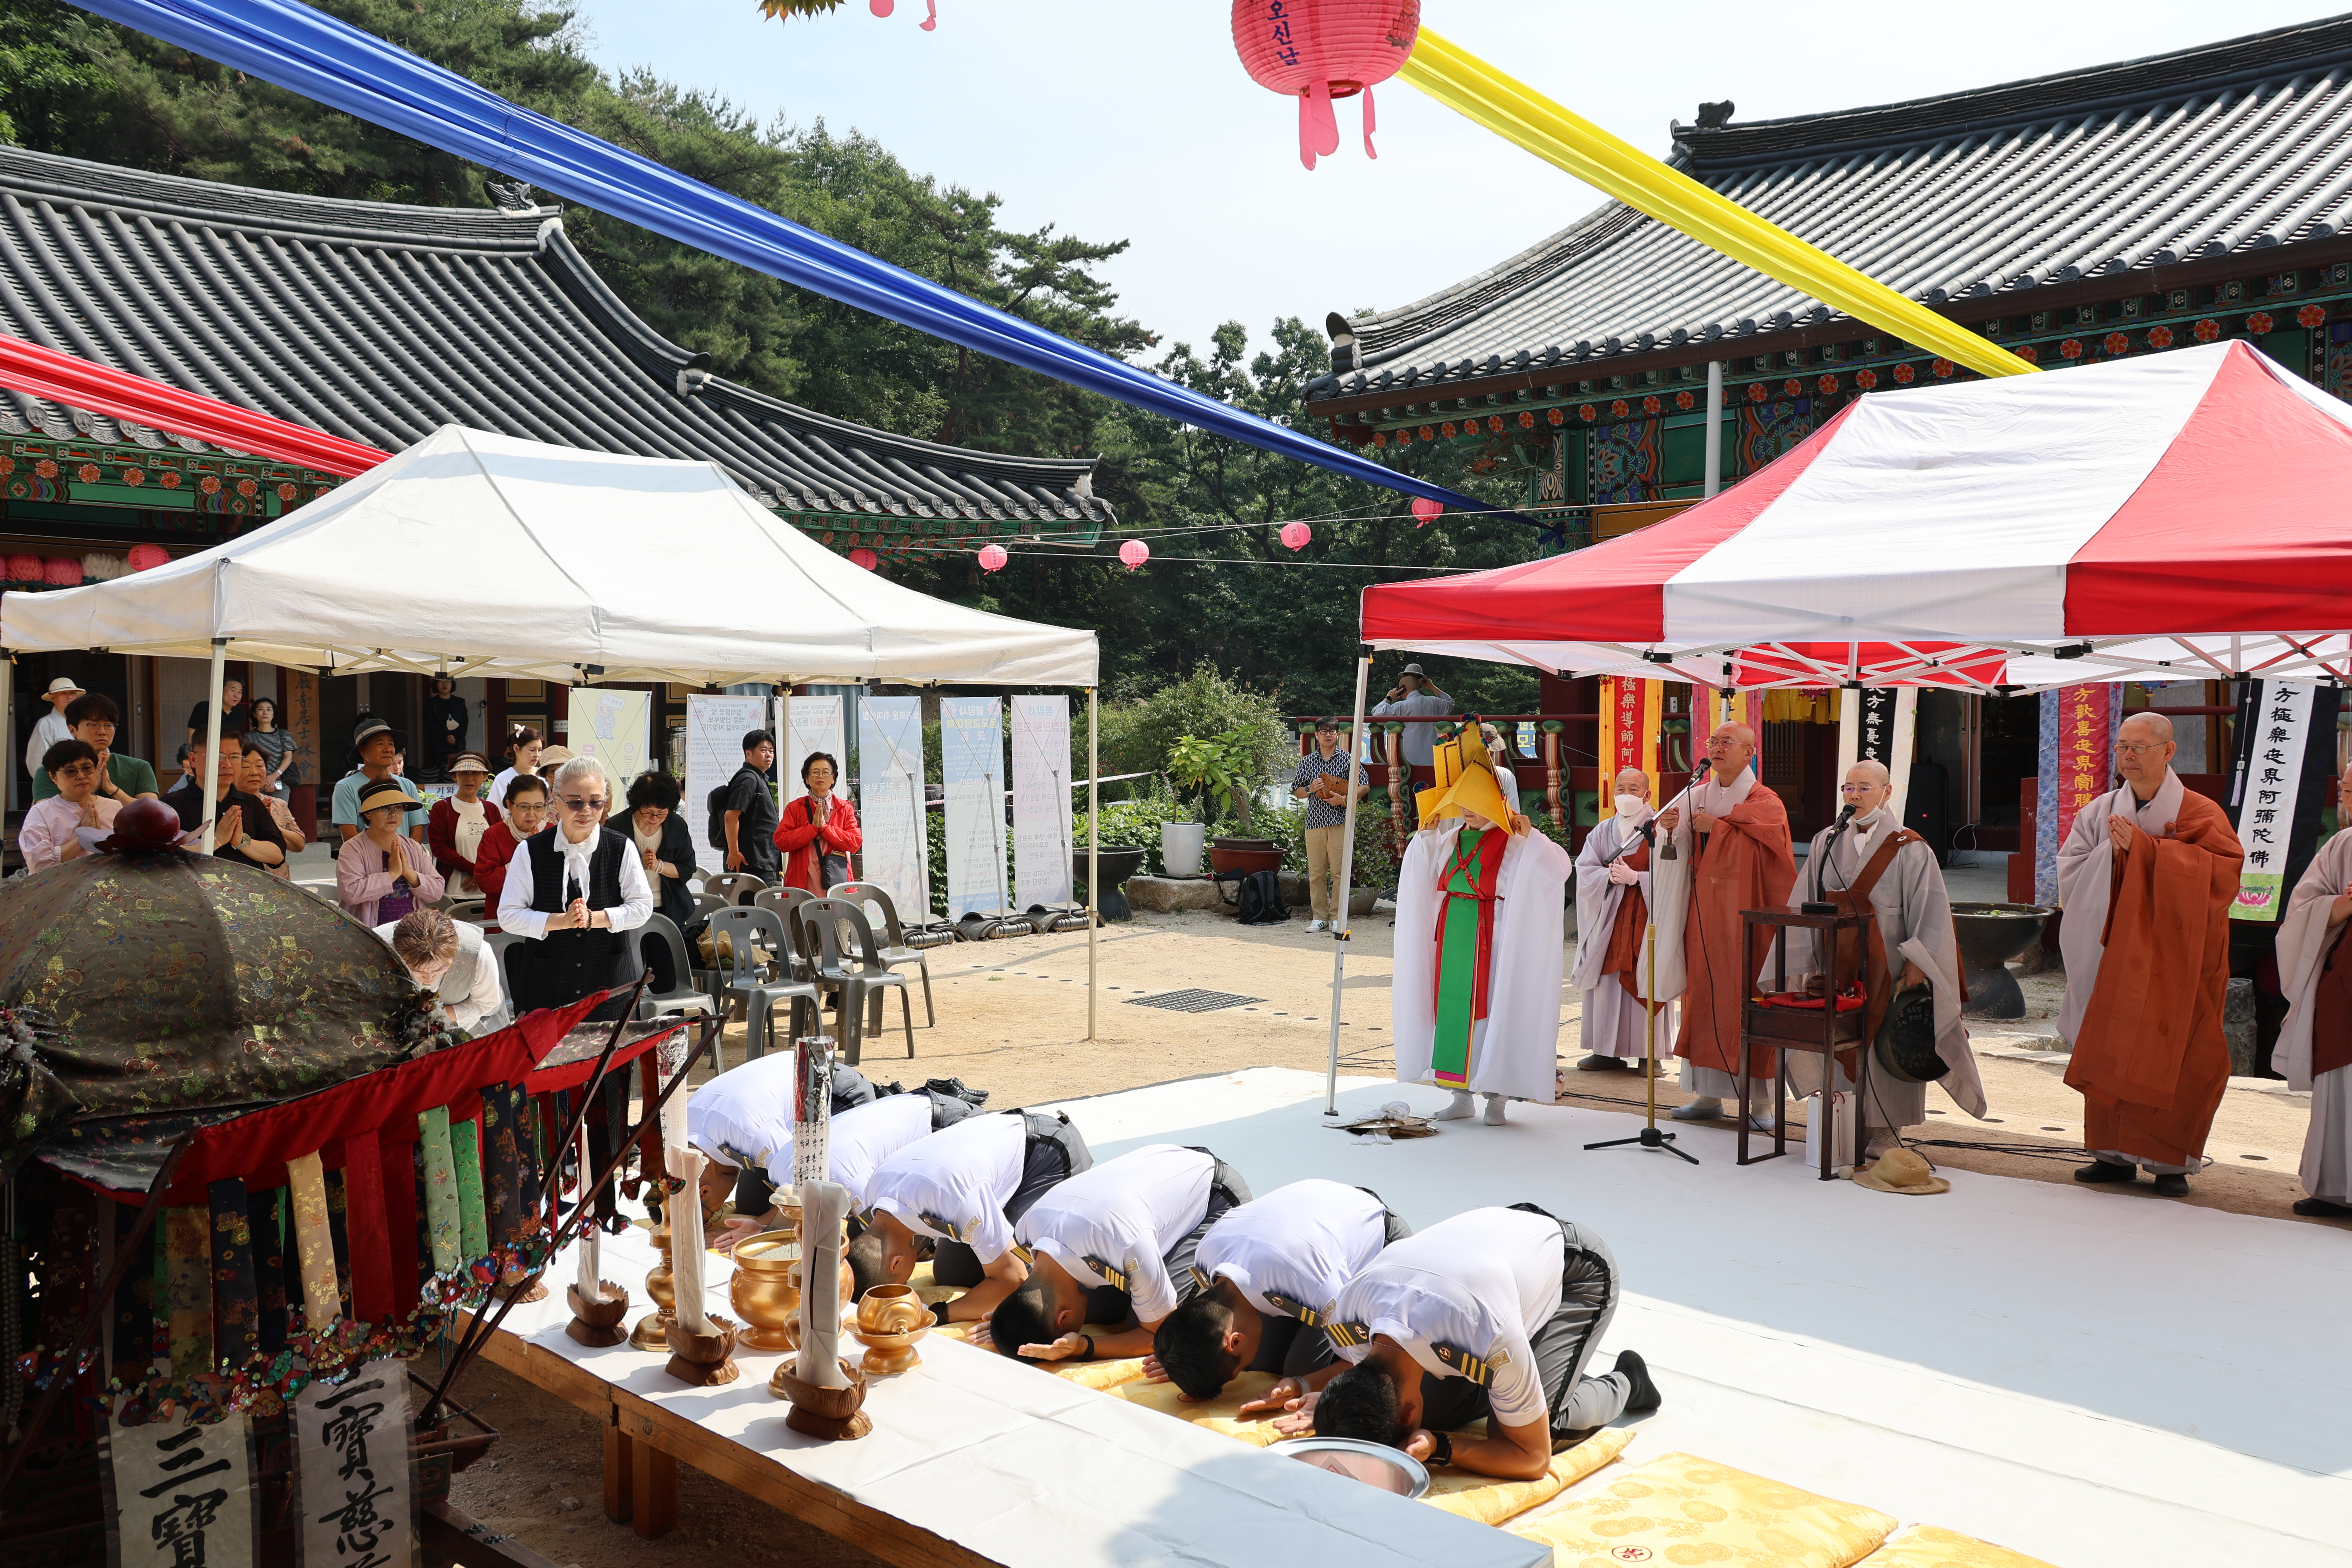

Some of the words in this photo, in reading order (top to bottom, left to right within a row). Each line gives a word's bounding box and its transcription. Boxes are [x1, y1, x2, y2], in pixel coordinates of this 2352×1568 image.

[1267, 0, 1300, 66] 오신날
[2249, 681, 2300, 869] 方極樂世界阿彌陀佛
